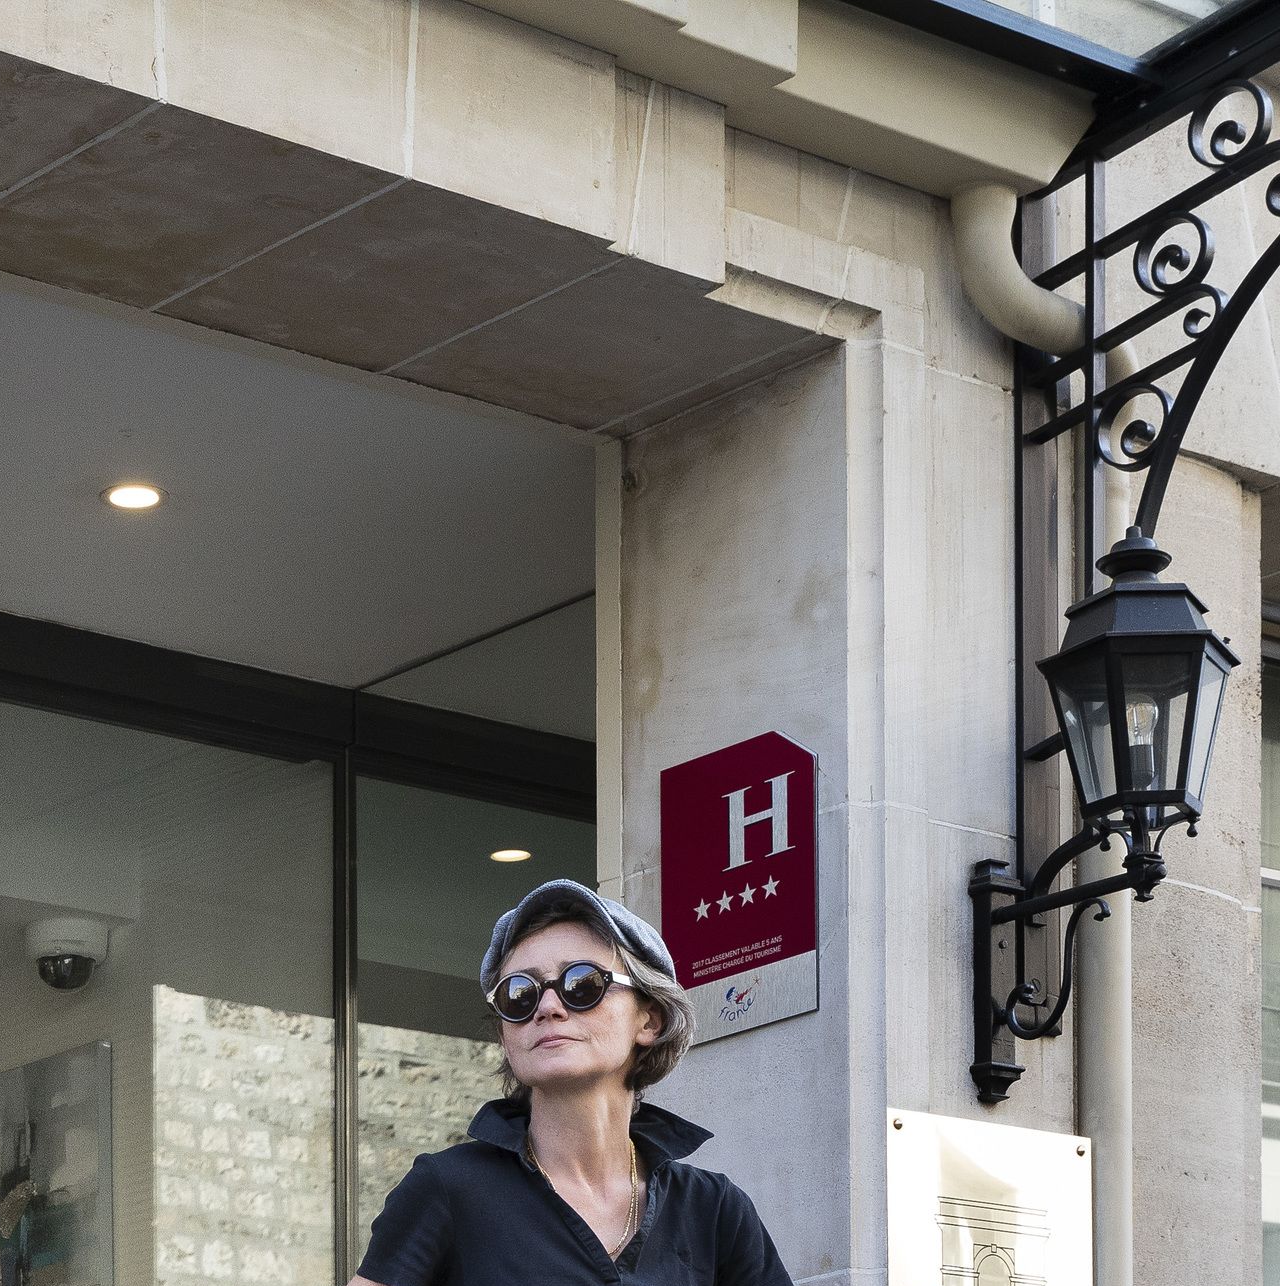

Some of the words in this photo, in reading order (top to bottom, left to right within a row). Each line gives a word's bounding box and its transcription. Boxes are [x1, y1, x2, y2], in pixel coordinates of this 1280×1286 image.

[721, 770, 795, 872] H
[692, 958, 704, 970] 2017
[704, 947, 740, 966] CLASSEMENT
[741, 940, 765, 956] VALABLE
[770, 935, 783, 945] ANS
[693, 964, 721, 979] MINISTÈRE
[722, 956, 745, 972] CHARGÉ
[745, 953, 753, 964] DU
[754, 946, 781, 961] TOURISME
